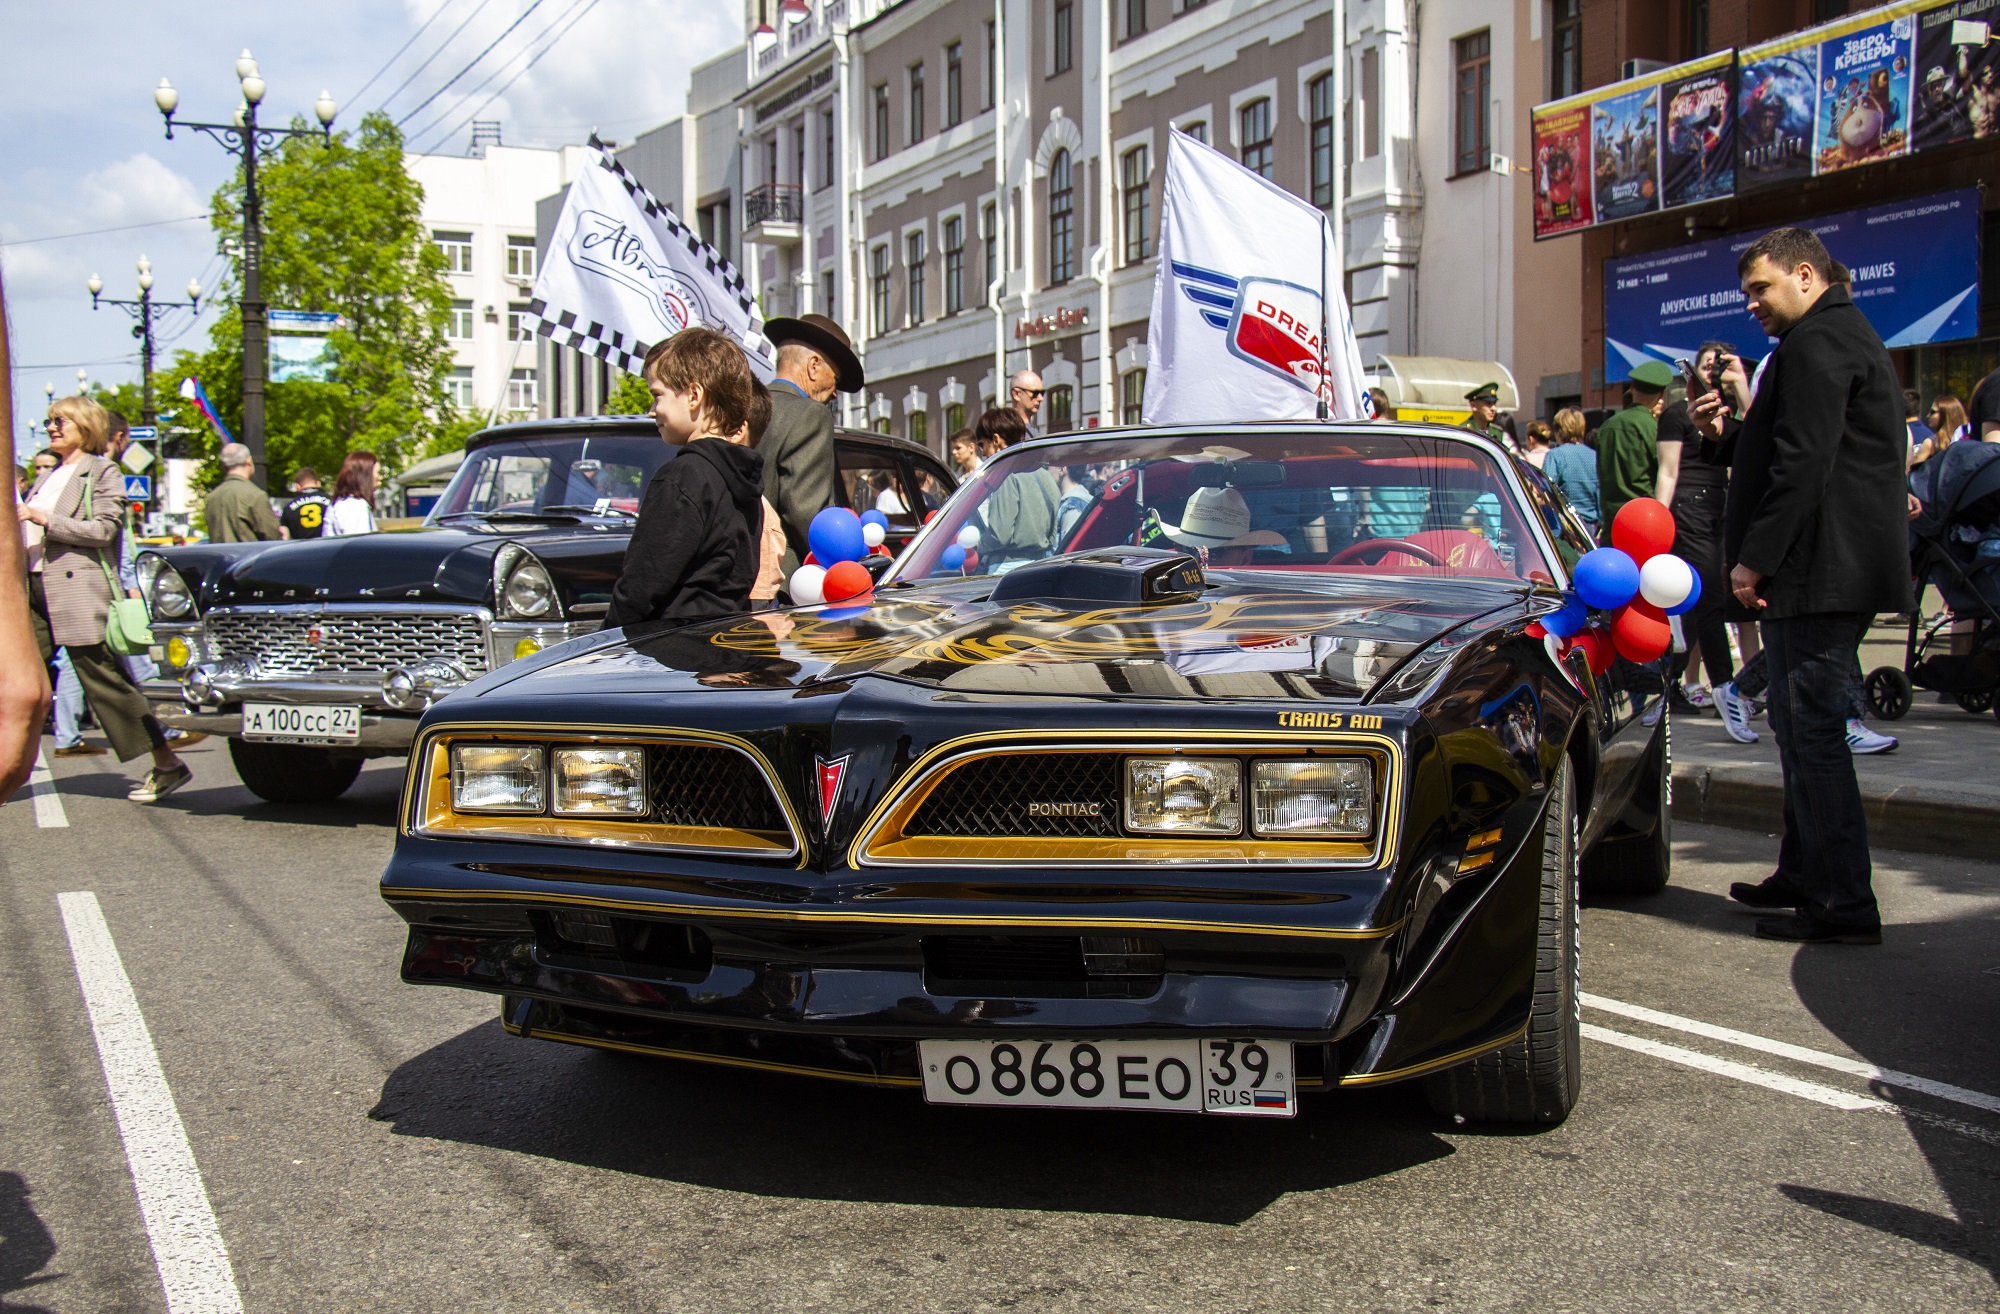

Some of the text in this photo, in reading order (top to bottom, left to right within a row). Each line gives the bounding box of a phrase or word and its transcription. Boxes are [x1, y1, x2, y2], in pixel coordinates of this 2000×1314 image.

[1923, 3, 1959, 28] ПОЛНЫЙ
[1834, 39, 1897, 71] КРЕКЕРЫ
[1843, 33, 1885, 56] ЗВЕРО
[1866, 200, 1960, 225] МИНИСТЕРСТВО ОБОРОНЫ РФ
[1616, 260, 1656, 274] ПРАВИТЕЛЬСТВО
[1858, 261, 1895, 281] WAVES
[1616, 279, 1626, 290] 24
[1626, 278, 1639, 288] мая
[1645, 274, 1650, 284] 1
[1650, 272, 1668, 284] июня
[1659, 294, 1708, 316] АМУРСКИЕ
[300, 503, 323, 529] 3
[332, 709, 352, 727] 27
[1277, 711, 1383, 729] TRANS AM
[1029, 803, 1099, 816] PONTIAC
[1209, 1042, 1269, 1089] 39
[1208, 1089, 1252, 1106] RUS
